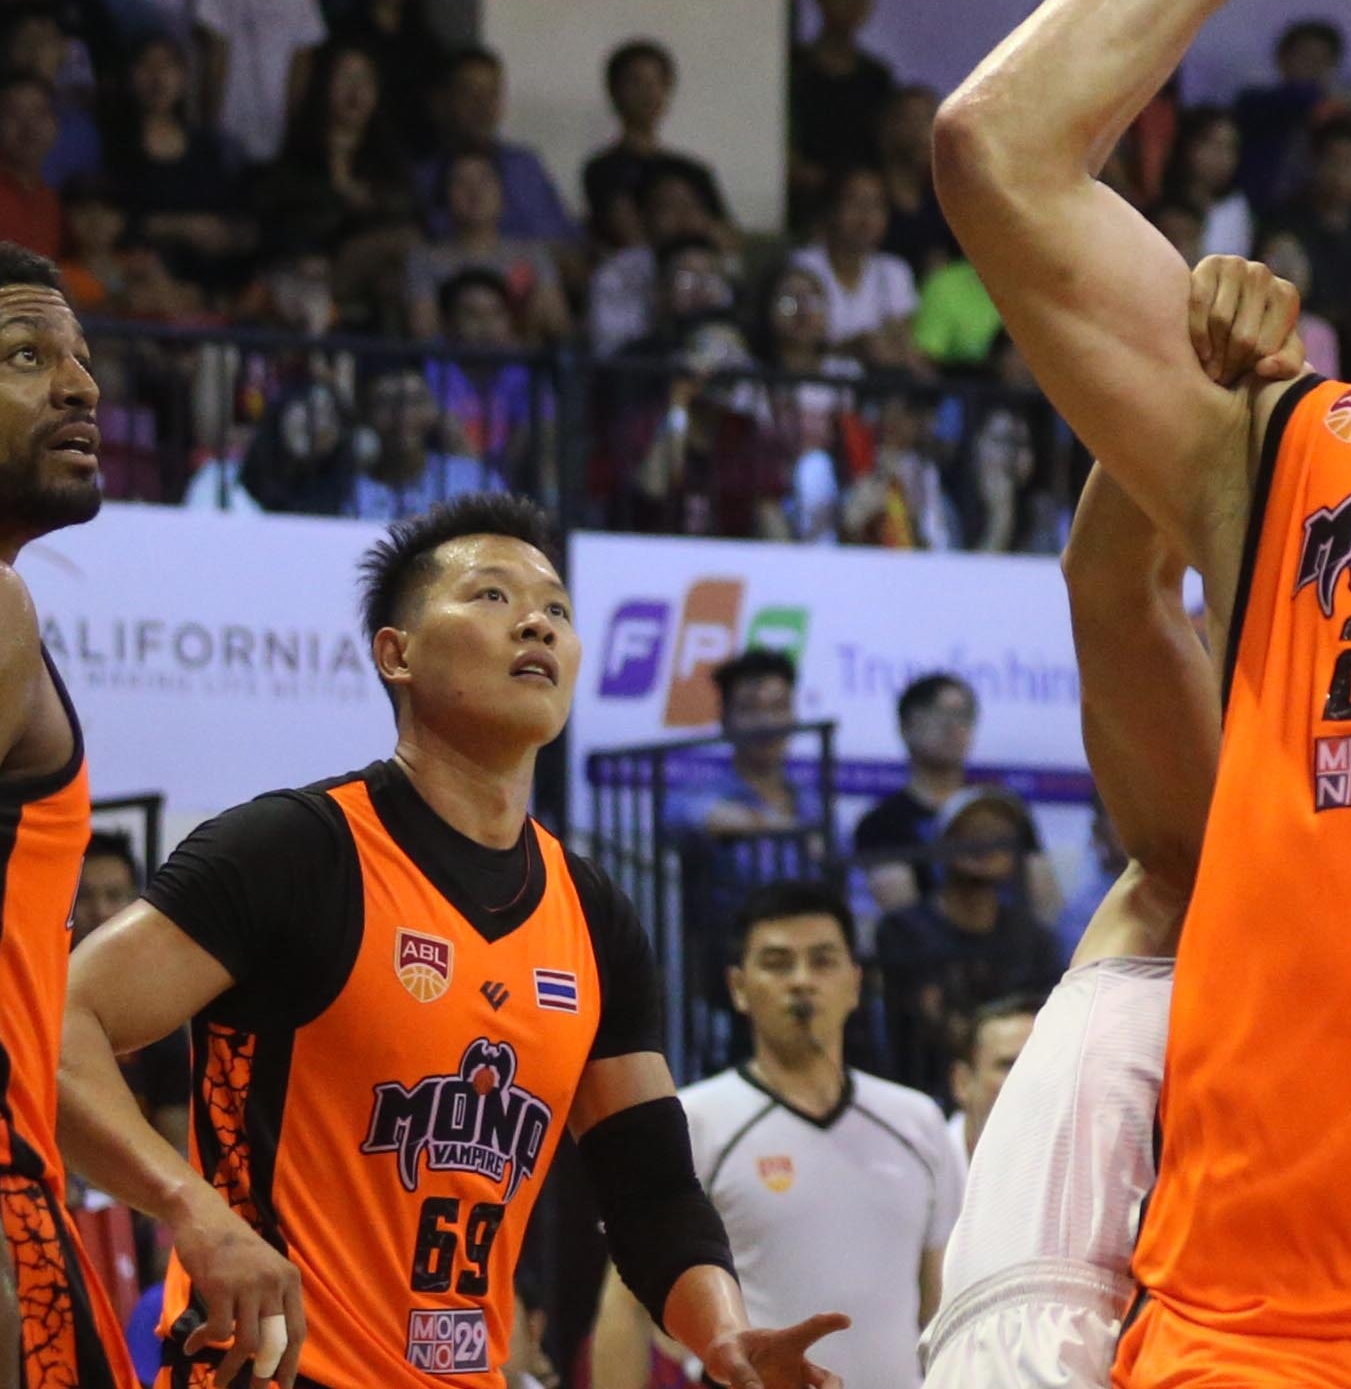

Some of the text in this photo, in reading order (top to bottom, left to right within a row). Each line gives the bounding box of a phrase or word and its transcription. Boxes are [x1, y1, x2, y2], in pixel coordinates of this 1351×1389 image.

[40, 614, 368, 674] ALIFORNIA
[401, 940, 447, 968] ABL
[362, 1079, 553, 1200] MONO
[433, 1143, 503, 1175] VAMPIRE
[411, 1197, 505, 1297] 69
[455, 1320, 487, 1361] 29
